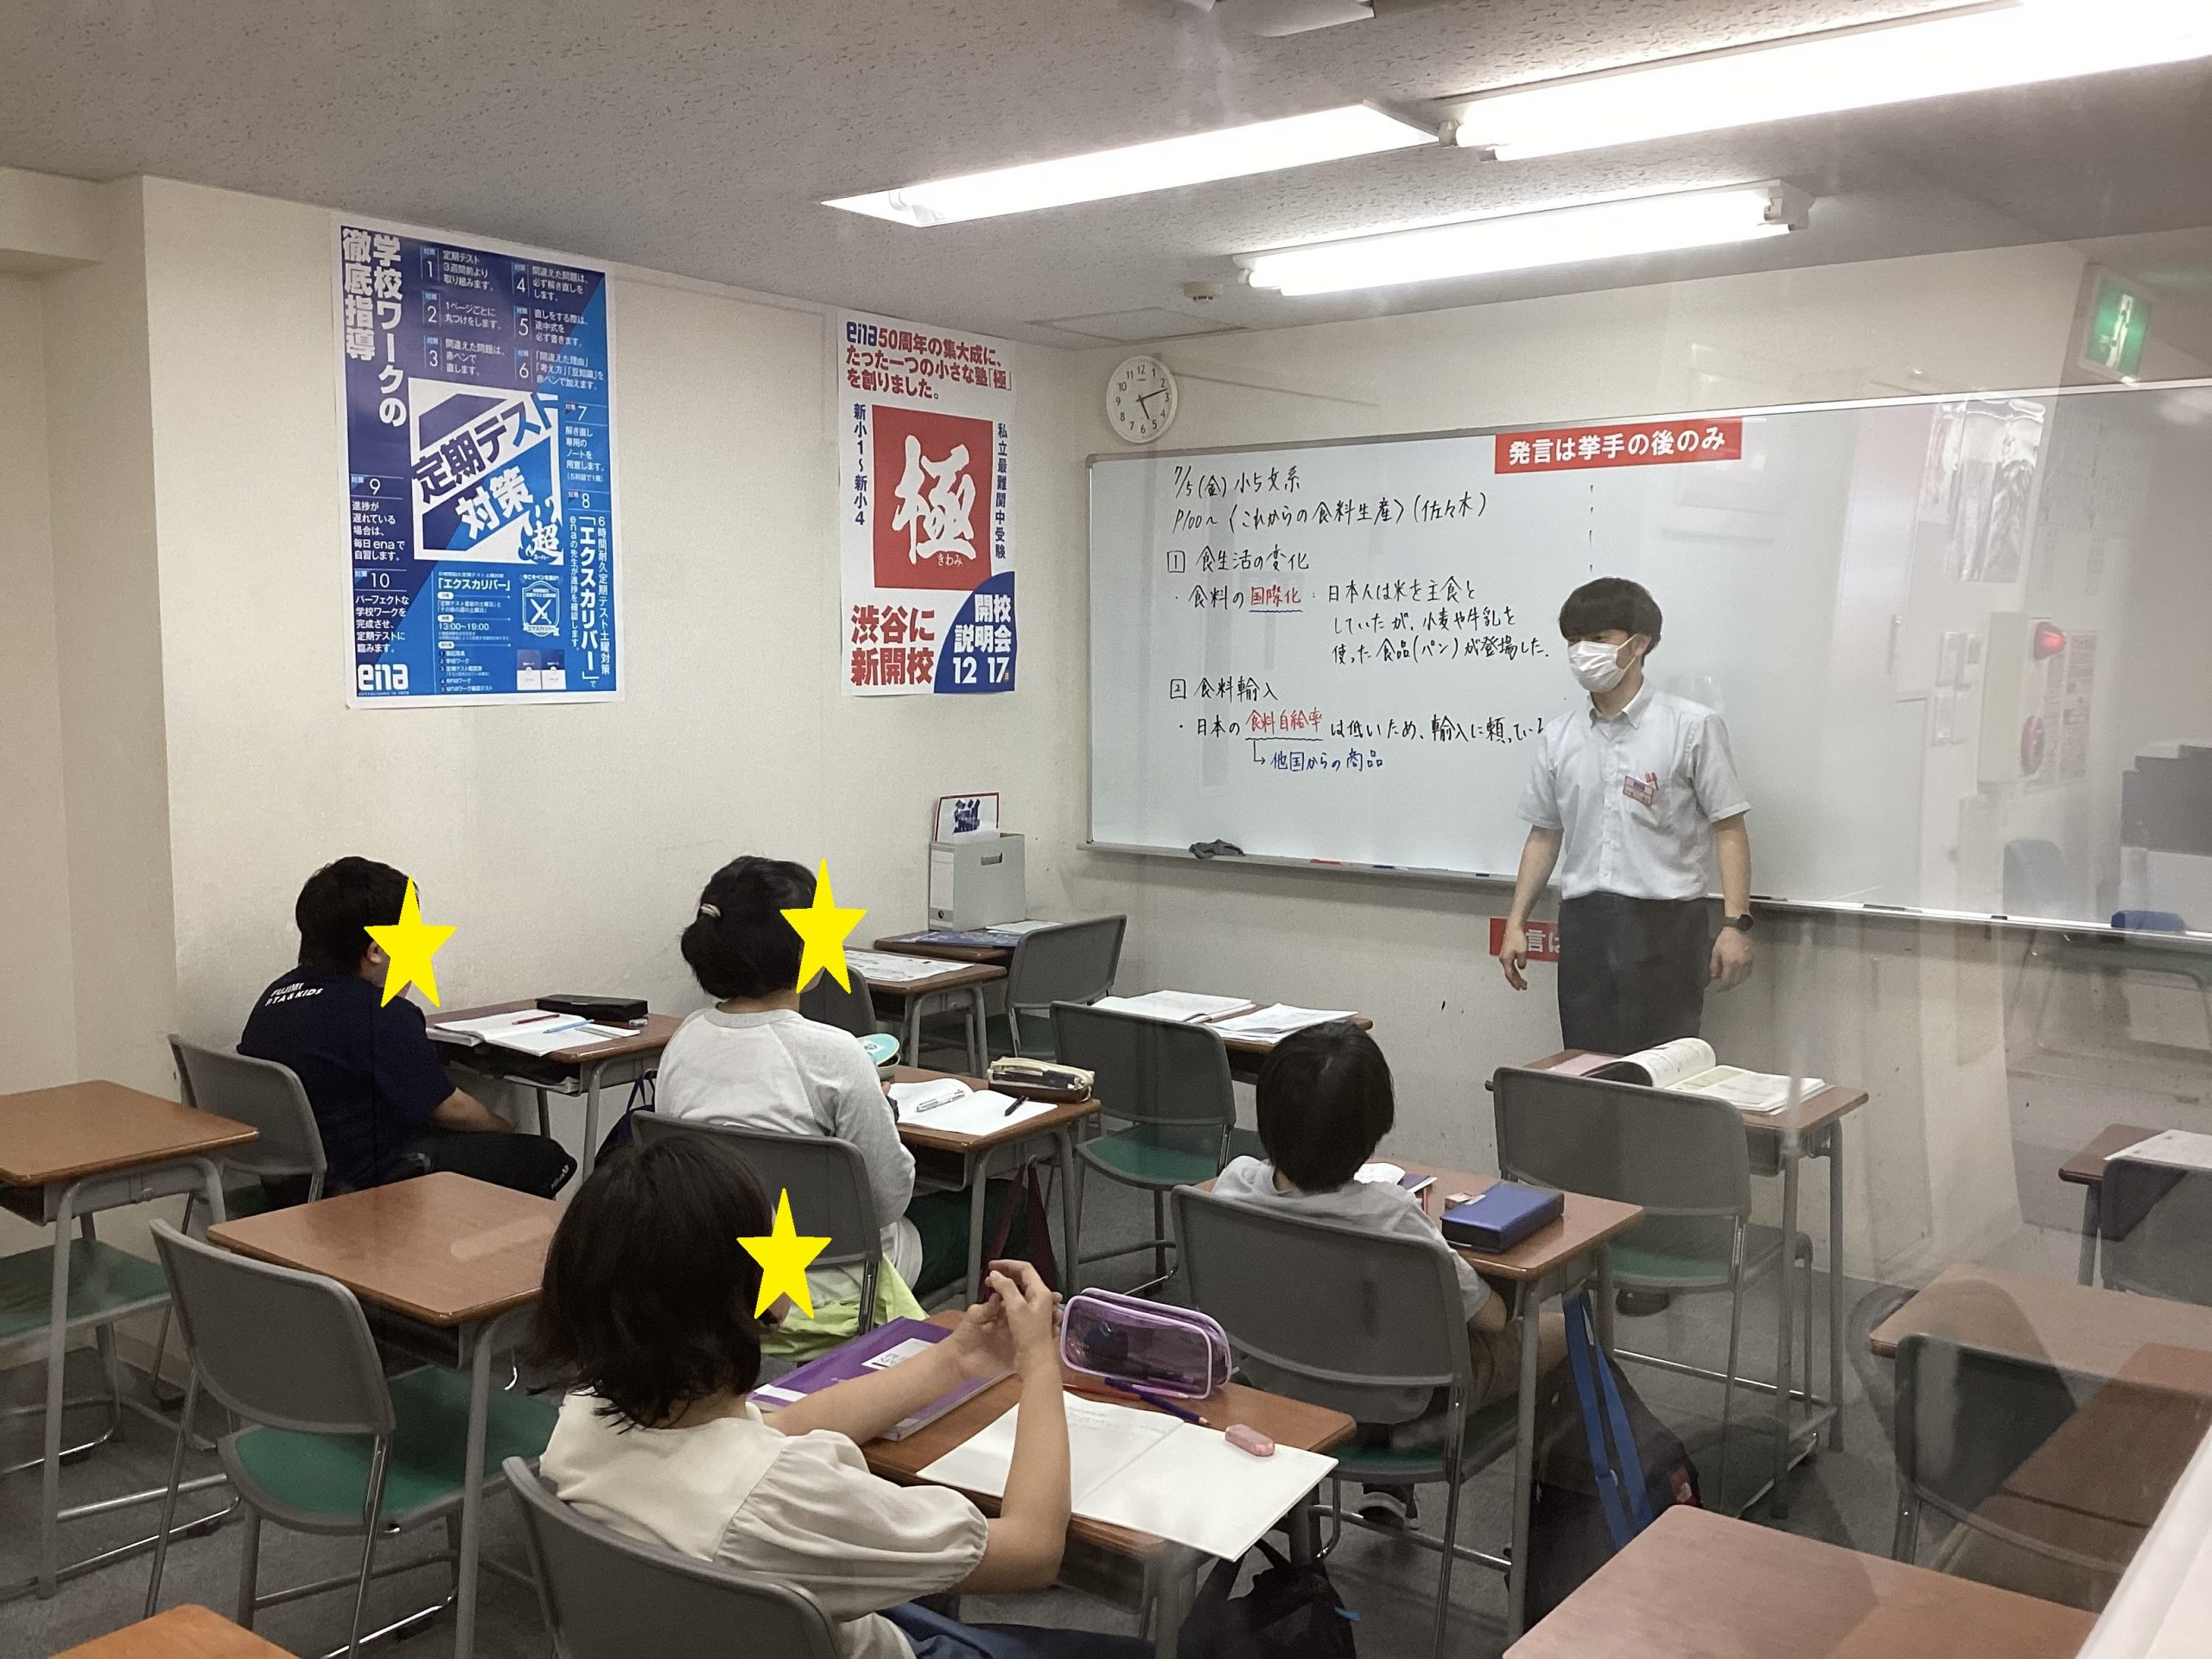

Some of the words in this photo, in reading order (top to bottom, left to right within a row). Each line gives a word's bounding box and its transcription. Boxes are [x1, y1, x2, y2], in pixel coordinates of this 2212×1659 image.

[442, 250, 480, 265] 定期テスト
[427, 261, 434, 277] 1
[517, 277, 526, 293] 4
[342, 227, 376, 361] 徹底指導
[534, 289, 558, 302] します。
[427, 306, 437, 323] 2
[445, 302, 496, 317] 1ページごとに
[373, 232, 407, 428] 学校ワークの
[518, 318, 529, 336] 5
[846, 321, 1002, 367] ena50周年の集大成に、
[429, 350, 438, 367] 3
[446, 363, 480, 376] 直します。
[518, 362, 529, 378] 6
[846, 345, 1013, 391] たった一つの小さな塾「極」
[1126, 370, 1134, 379] 11
[1137, 364, 1146, 374] 12
[1152, 368, 1156, 378] 1
[847, 367, 939, 400] を創りました。
[1118, 381, 1128, 391] 10
[1160, 378, 1166, 388] 2
[1116, 397, 1122, 406] 9
[1164, 392, 1170, 403] 3
[578, 405, 588, 422] 7
[1120, 411, 1126, 422] 8
[1160, 409, 1166, 418] 4
[565, 425, 594, 437] 解き直し
[1129, 421, 1135, 431] 7
[1140, 424, 1146, 434] 6
[1152, 419, 1158, 429] 5
[412, 391, 558, 504] 定期テスト
[565, 437, 588, 448] 専用の
[1508, 426, 1726, 466] 発言は挙手の後のみ
[567, 448, 594, 460] ノートを
[566, 460, 605, 472] 用意します。
[369, 478, 381, 495] 9
[995, 423, 1008, 559] 私立最難関中受験
[352, 500, 379, 512] 進捗が
[455, 465, 534, 539] 対策
[582, 493, 590, 509] 8
[891, 435, 977, 565] 極
[353, 512, 396, 524] 遅れている
[353, 524, 385, 537] 場合は、
[354, 550, 400, 562] 自習します。
[937, 554, 963, 567] きわみ
[1196, 544, 1310, 573] 食生活の変化
[371, 572, 391, 588] 10
[438, 577, 511, 591] 「エクスカリバー」
[355, 594, 410, 606] パーフェクトな
[355, 607, 407, 618] 学校ワークを
[975, 594, 1012, 623] 開校
[356, 619, 395, 629] 完成させ、
[850, 605, 935, 644] 渋谷に
[356, 631, 406, 641] 定期テストに
[953, 624, 1013, 653] 説明会
[850, 647, 935, 686] 新開校
[952, 657, 977, 684] 12
[987, 657, 1010, 683] 17
[357, 663, 410, 691] ena
[1194, 676, 1279, 702] 食料輸入
[1269, 748, 1384, 772] 他国からの商品
